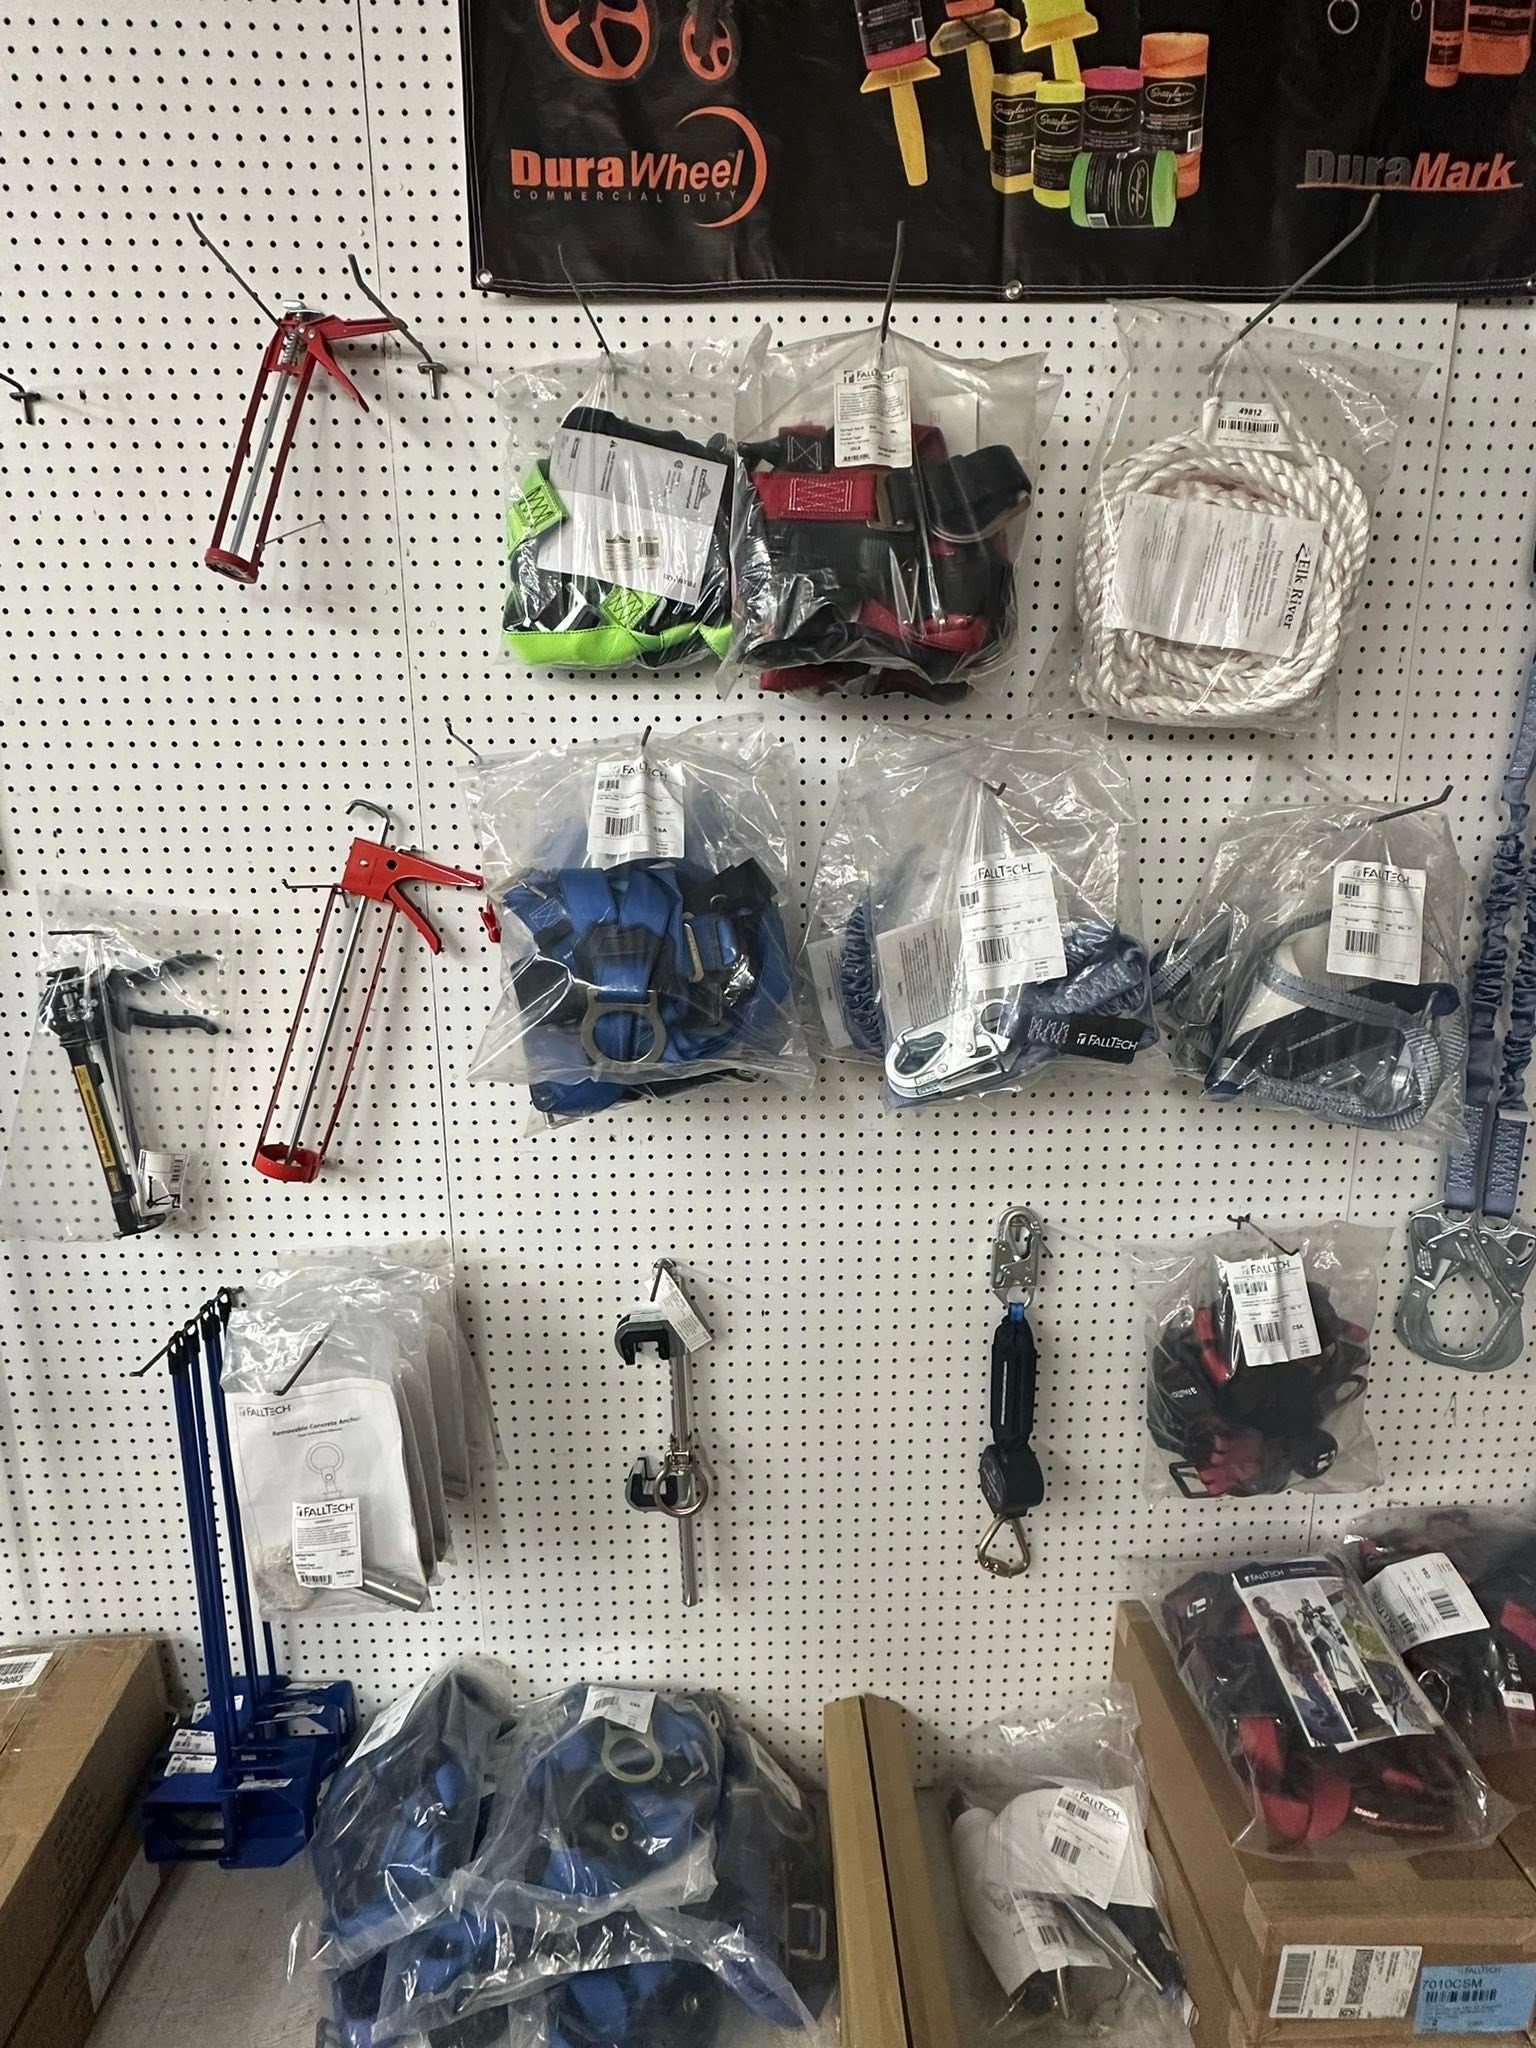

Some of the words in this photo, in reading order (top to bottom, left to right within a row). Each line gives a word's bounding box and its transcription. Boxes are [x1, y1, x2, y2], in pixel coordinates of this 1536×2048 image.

[513, 189, 663, 203] COMMERCIAL
[683, 190, 738, 204] DUTY
[856, 368, 896, 380] FALLTCH
[1239, 407, 1263, 416] 49812
[1295, 559, 1311, 583] Elk
[1284, 588, 1304, 629] River
[978, 862, 1033, 880] FALLTECH
[1363, 867, 1410, 884] FALLTECH
[1088, 1035, 1138, 1050] FALLTECH
[1250, 1260, 1290, 1274] FALLTCH
[247, 1404, 291, 1417] FALLTECH
[272, 1426, 308, 1437] Removable
[309, 1420, 338, 1429] Concrete
[304, 1503, 355, 1517] FALLTECH
[1079, 1791, 1120, 1820] FALLTECH
[1423, 1979, 1484, 1989] 7010CSM
